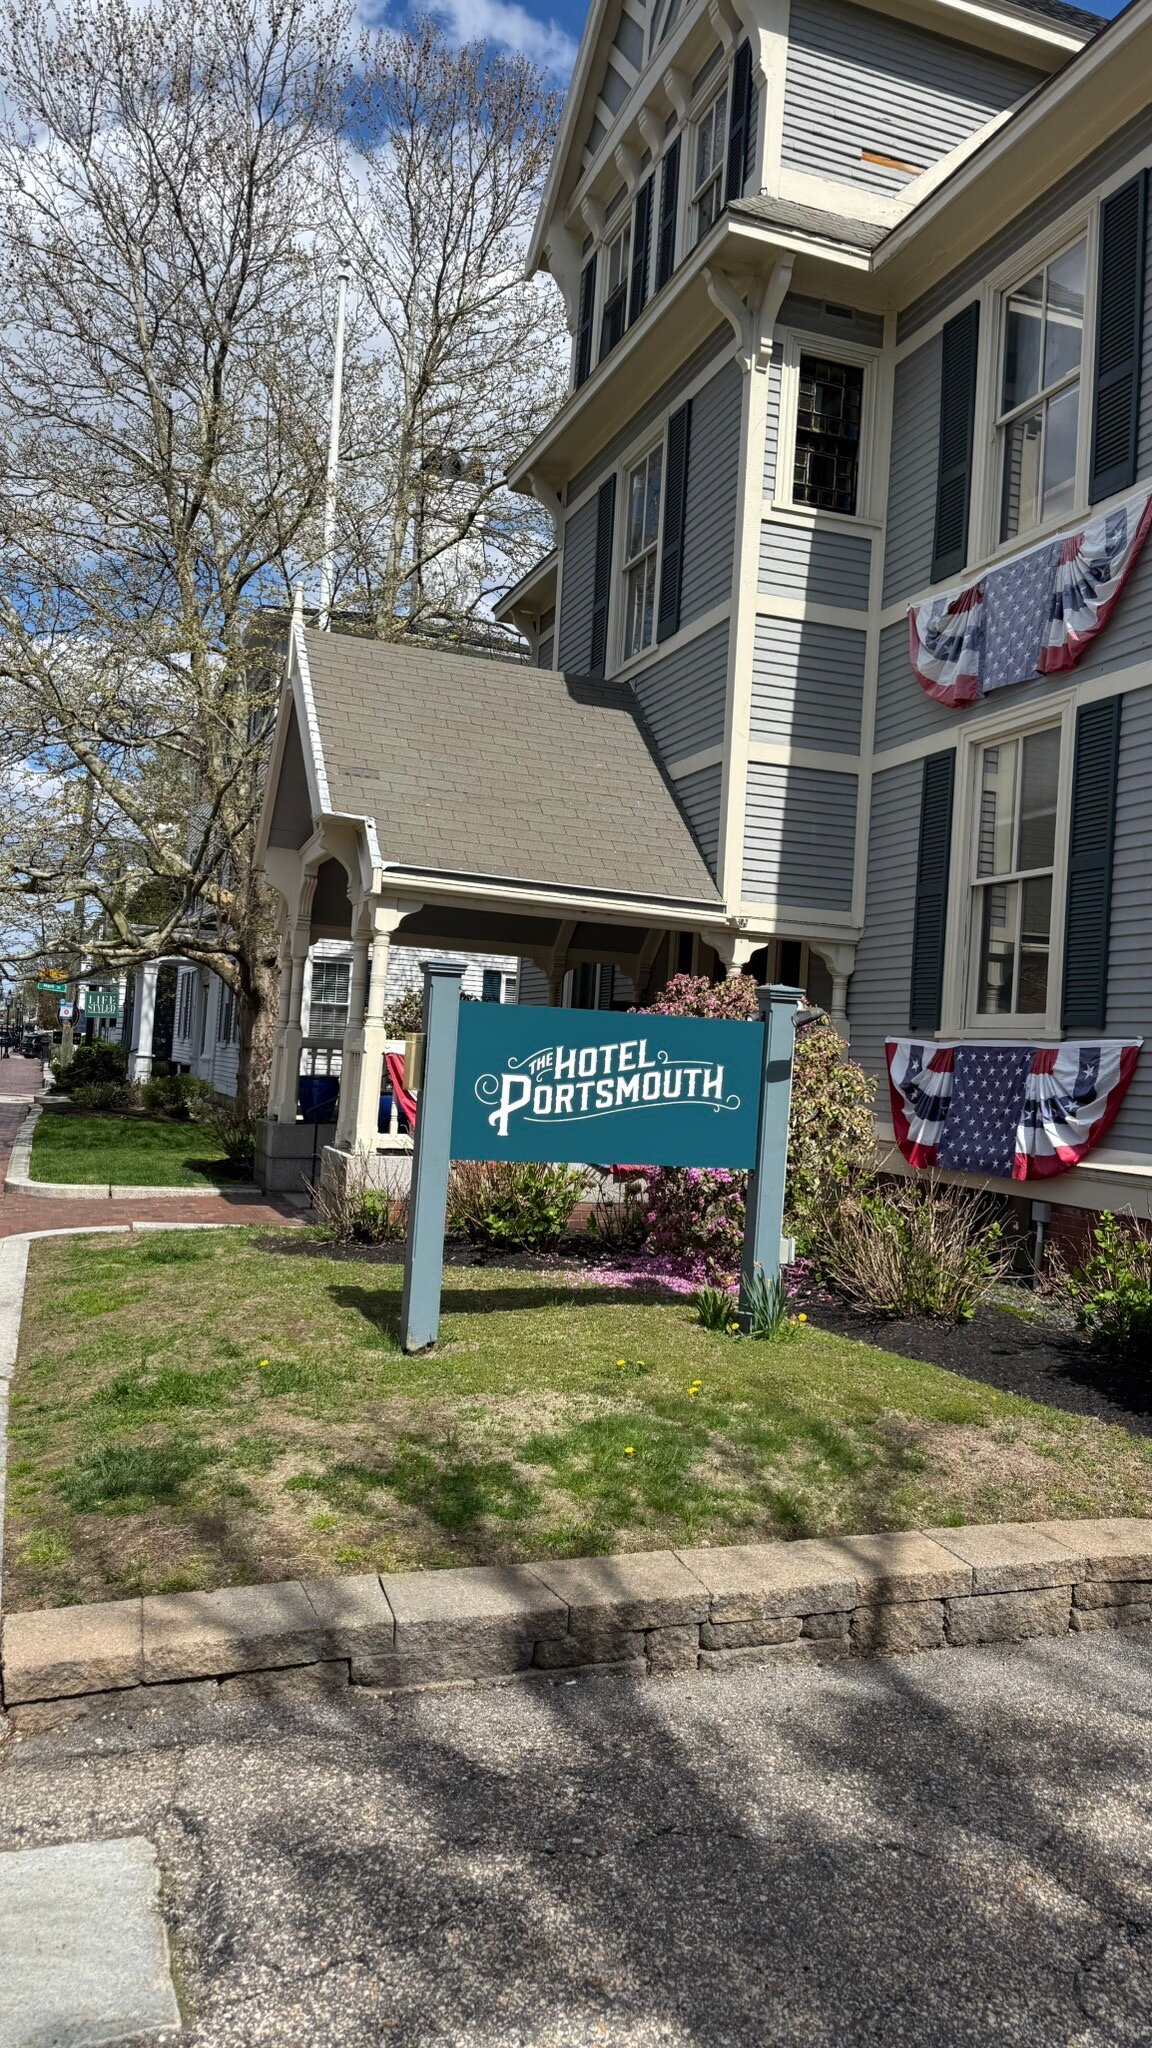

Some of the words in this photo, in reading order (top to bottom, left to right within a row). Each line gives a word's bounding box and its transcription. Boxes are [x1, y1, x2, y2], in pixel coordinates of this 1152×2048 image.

[88, 1002, 116, 1012] STYLED
[89, 995, 116, 1004] LIFE
[528, 1050, 554, 1075] THE
[553, 1038, 656, 1080] HOTEL
[488, 1063, 725, 1137] PORTSMOUTH
